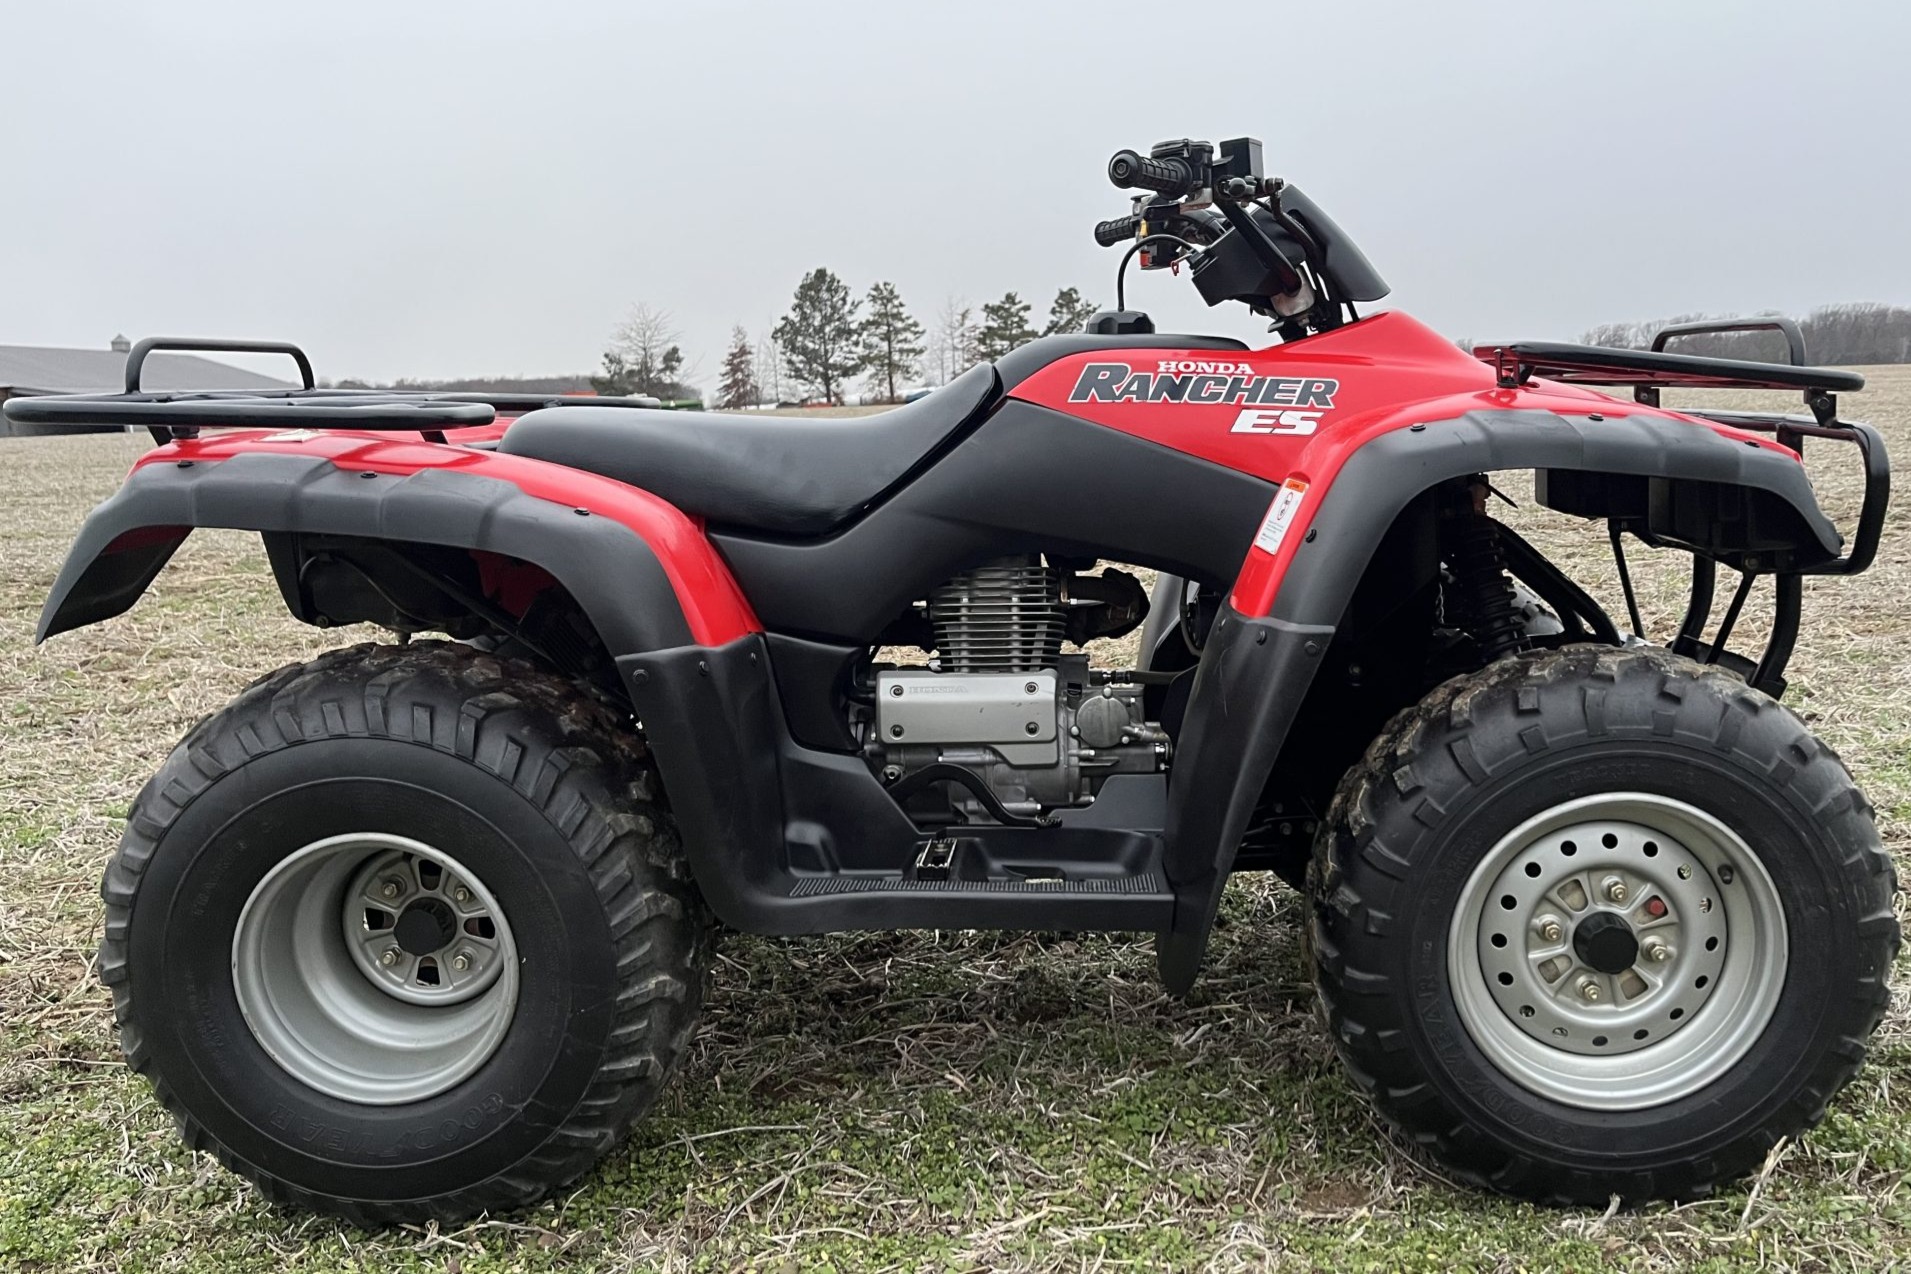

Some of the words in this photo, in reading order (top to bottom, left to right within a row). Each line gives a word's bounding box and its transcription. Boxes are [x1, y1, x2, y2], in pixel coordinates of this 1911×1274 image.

[1157, 361, 1254, 374] HONDA
[1067, 362, 1339, 408] RANCHER
[1230, 408, 1325, 436] ES
